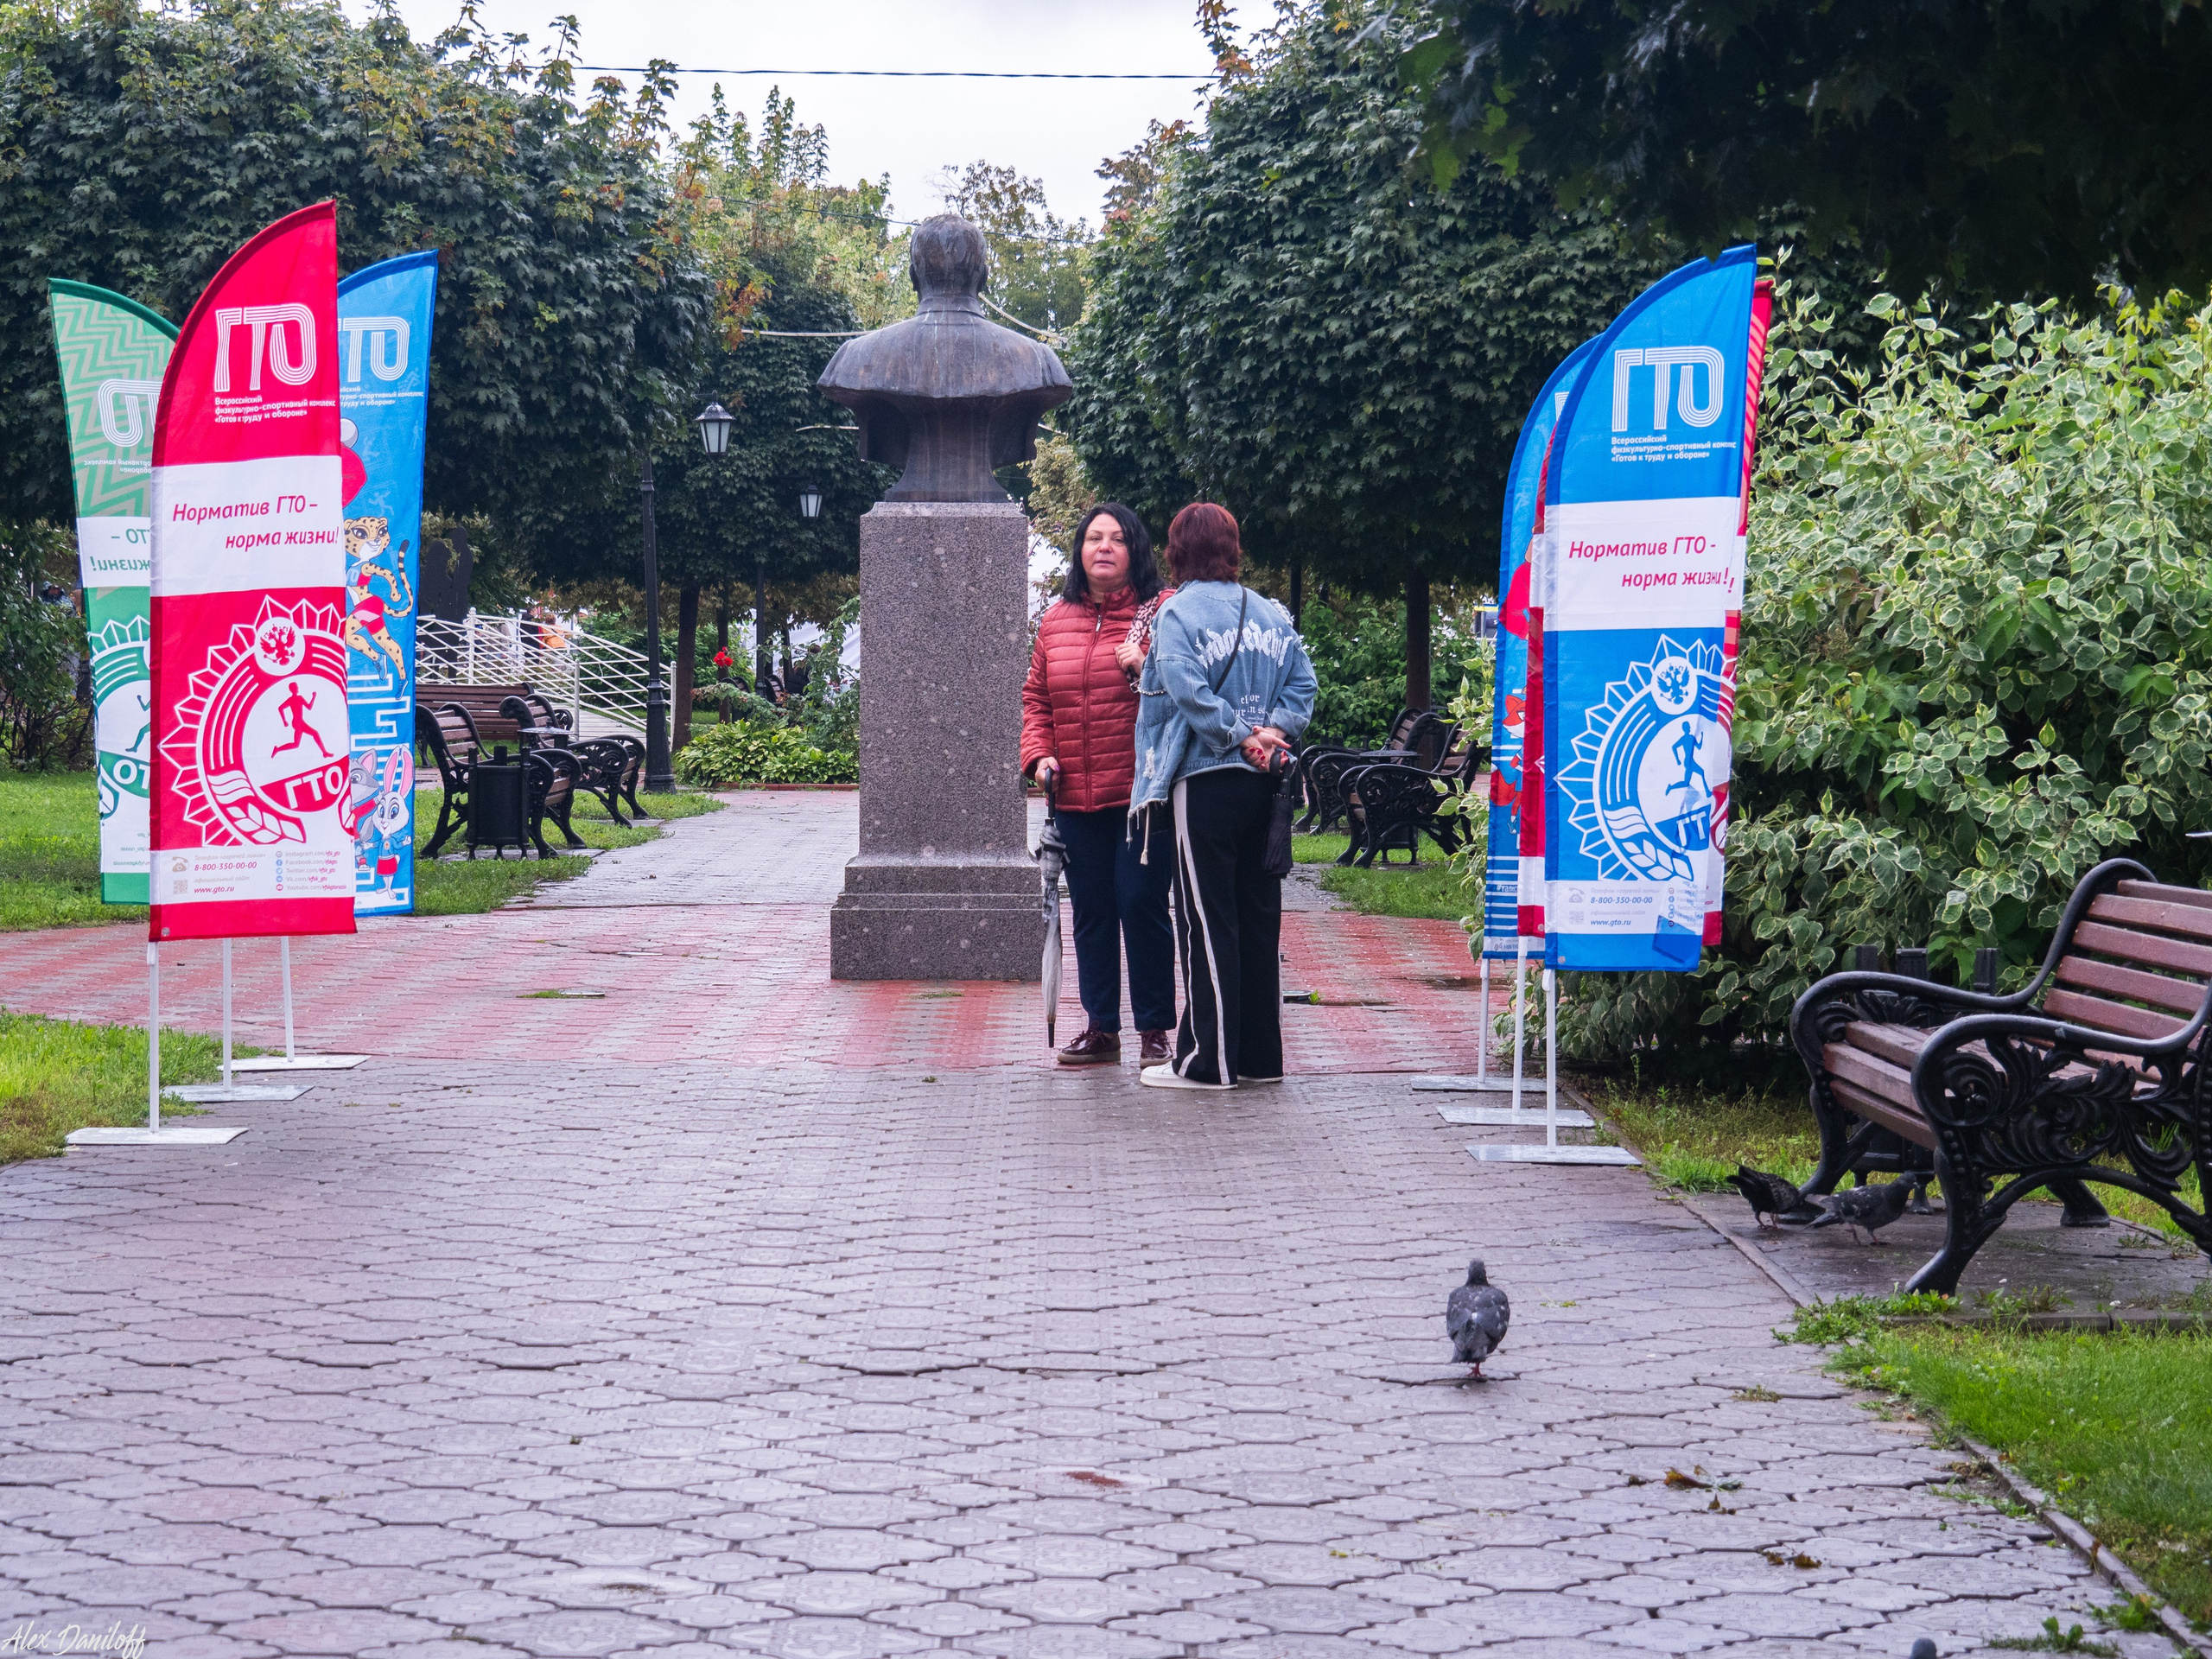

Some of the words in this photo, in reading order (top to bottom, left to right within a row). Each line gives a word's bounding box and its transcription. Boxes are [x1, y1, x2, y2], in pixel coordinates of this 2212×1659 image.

[214, 302, 316, 392] ГТО
[338, 316, 410, 382] ТО
[1611, 346, 1725, 432] ГТО
[1611, 435, 1667, 446] Всероссийский
[1611, 441, 1711, 454] физкультурно-спортивный
[1644, 453, 1665, 462] труду
[1674, 451, 1710, 461] обороне»
[173, 501, 270, 524] Норматив
[276, 494, 306, 513] ГТО
[226, 531, 282, 552] норма
[284, 526, 340, 544] жизни!
[1568, 540, 1668, 562] Норматив
[1673, 536, 1707, 555] ГТО
[1622, 572, 1677, 591] норма
[1681, 567, 1729, 585] жизни!
[285, 766, 343, 809] ГТО
[1676, 811, 1707, 847] ГТ
[194, 861, 257, 871] 8-800-350-00-00
